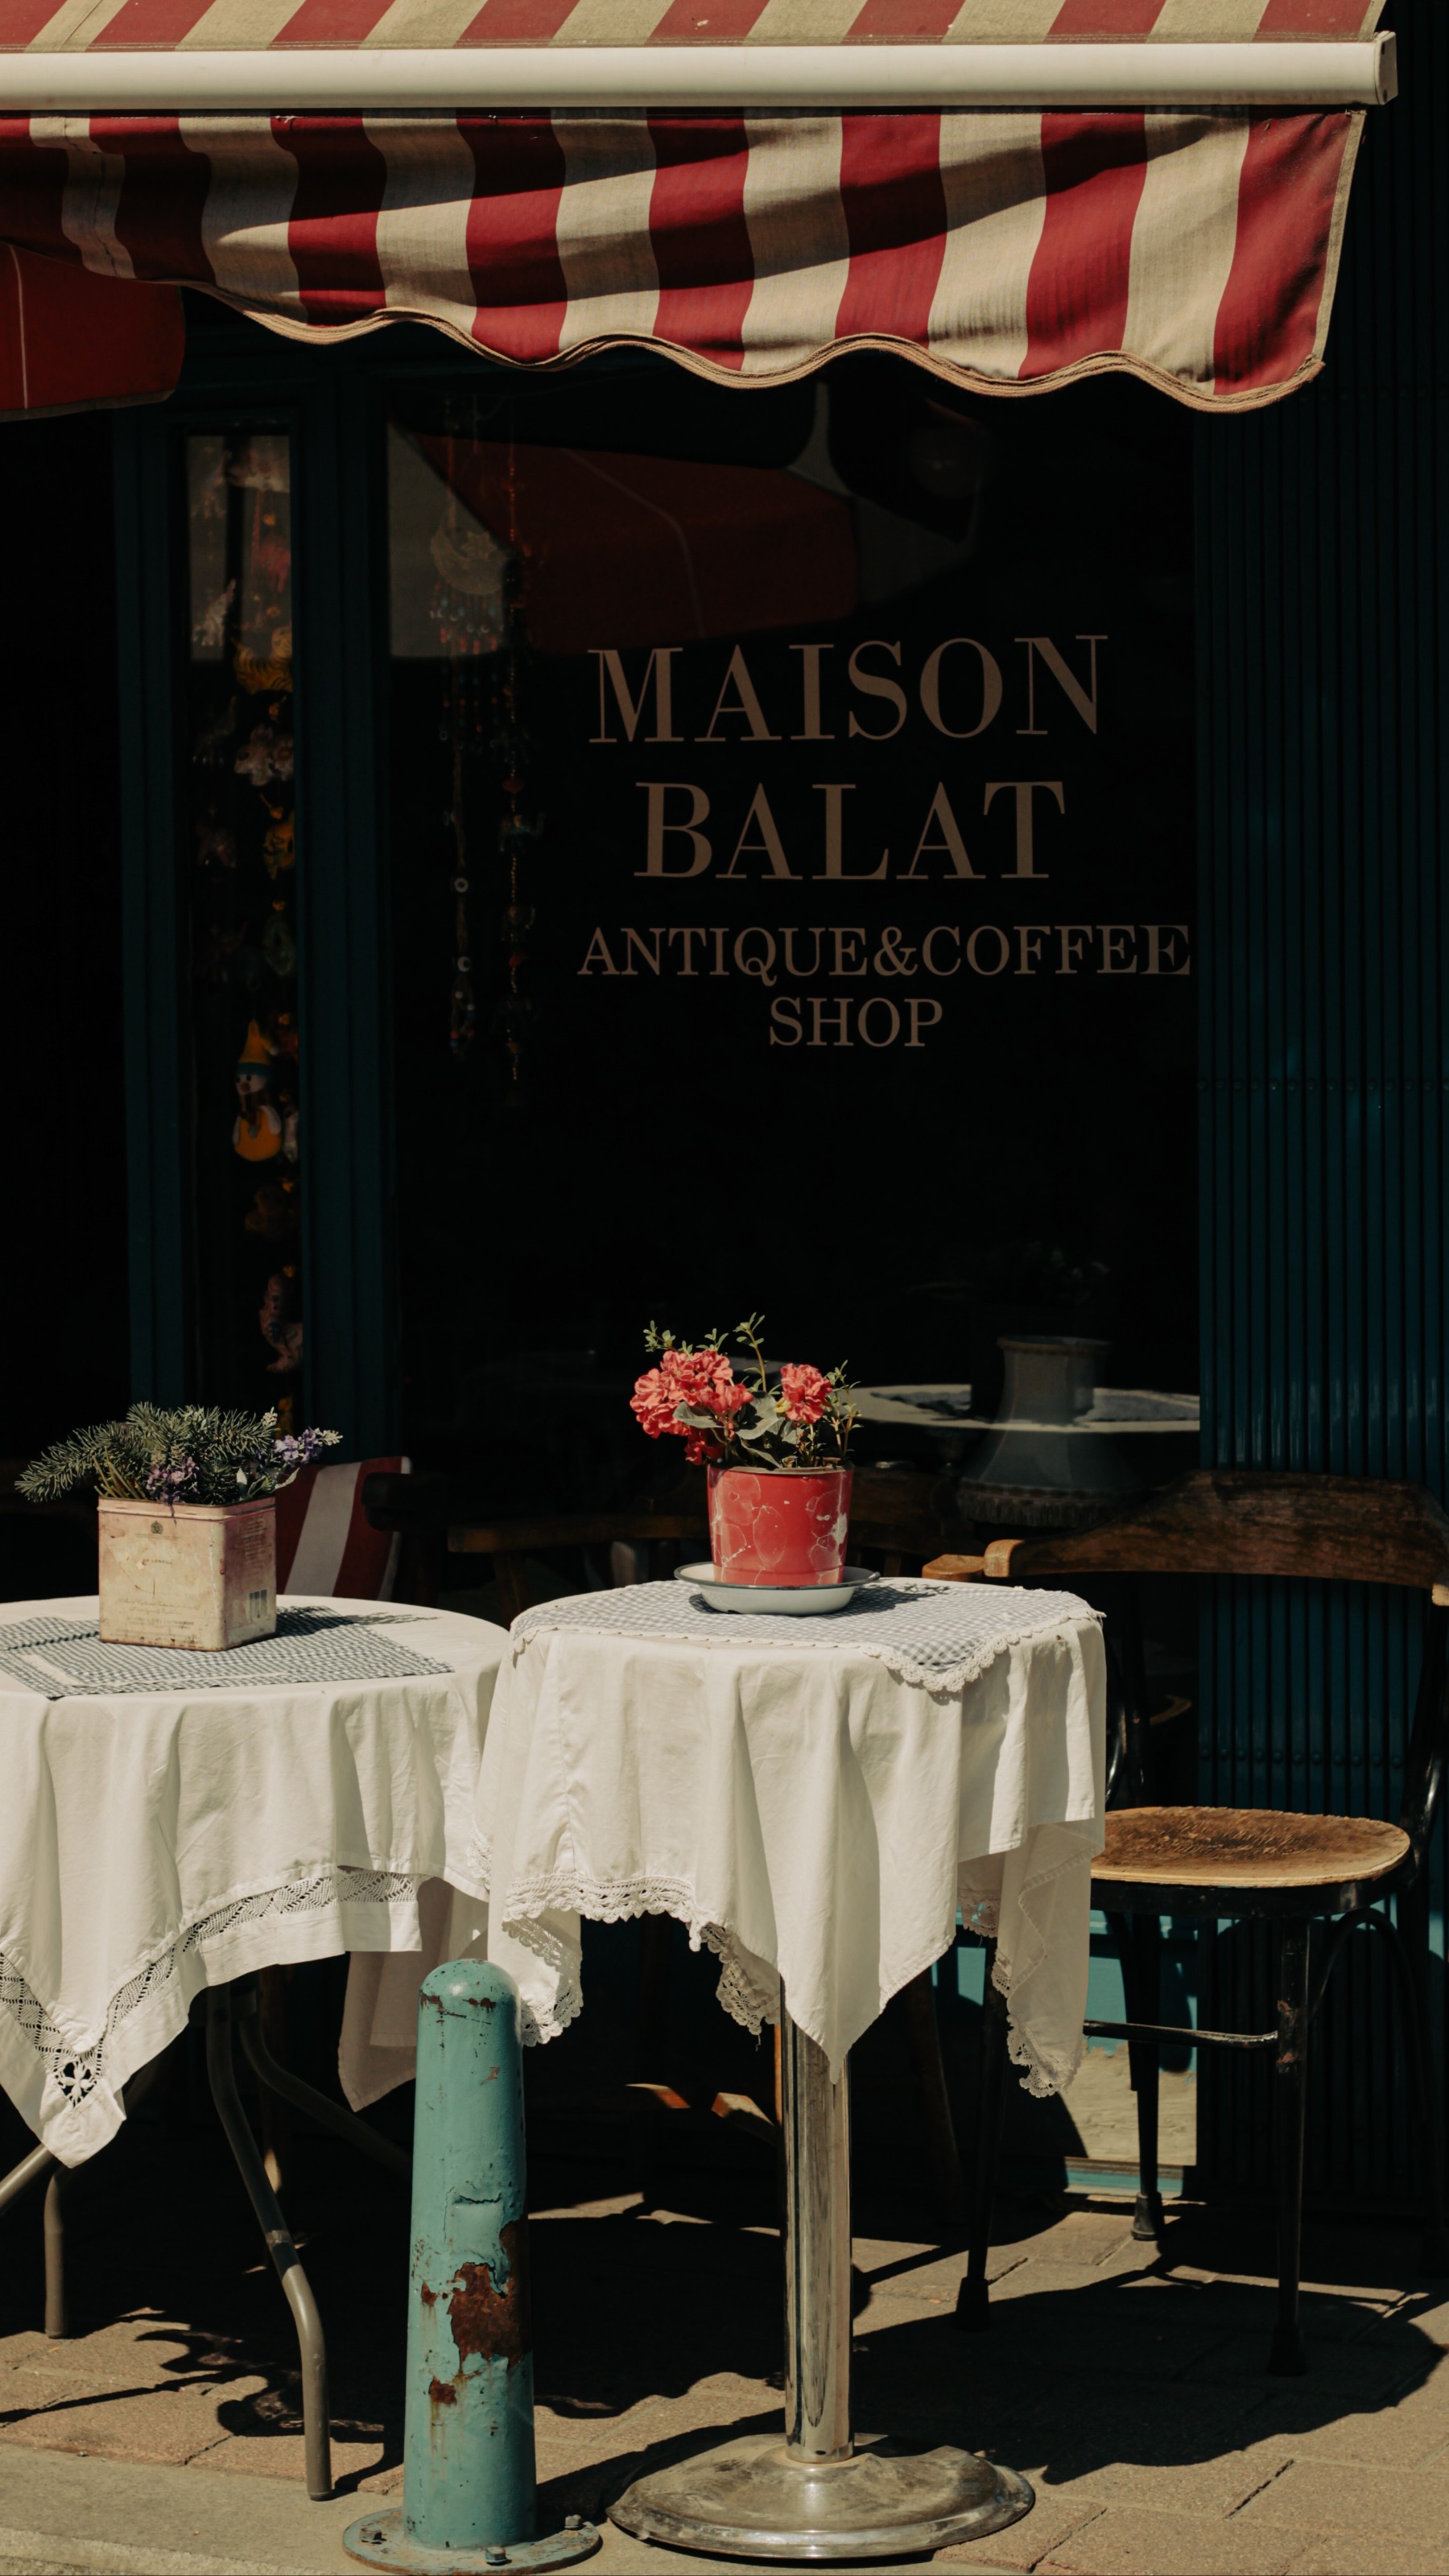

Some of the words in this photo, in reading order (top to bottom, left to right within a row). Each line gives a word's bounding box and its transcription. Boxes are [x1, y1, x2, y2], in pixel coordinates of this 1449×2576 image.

[588, 634, 1108, 743] MAISON
[634, 781, 1065, 880] BALAT
[577, 925, 1191, 986] ANTIQUE&COFFEE
[770, 997, 943, 1047] SHOP
